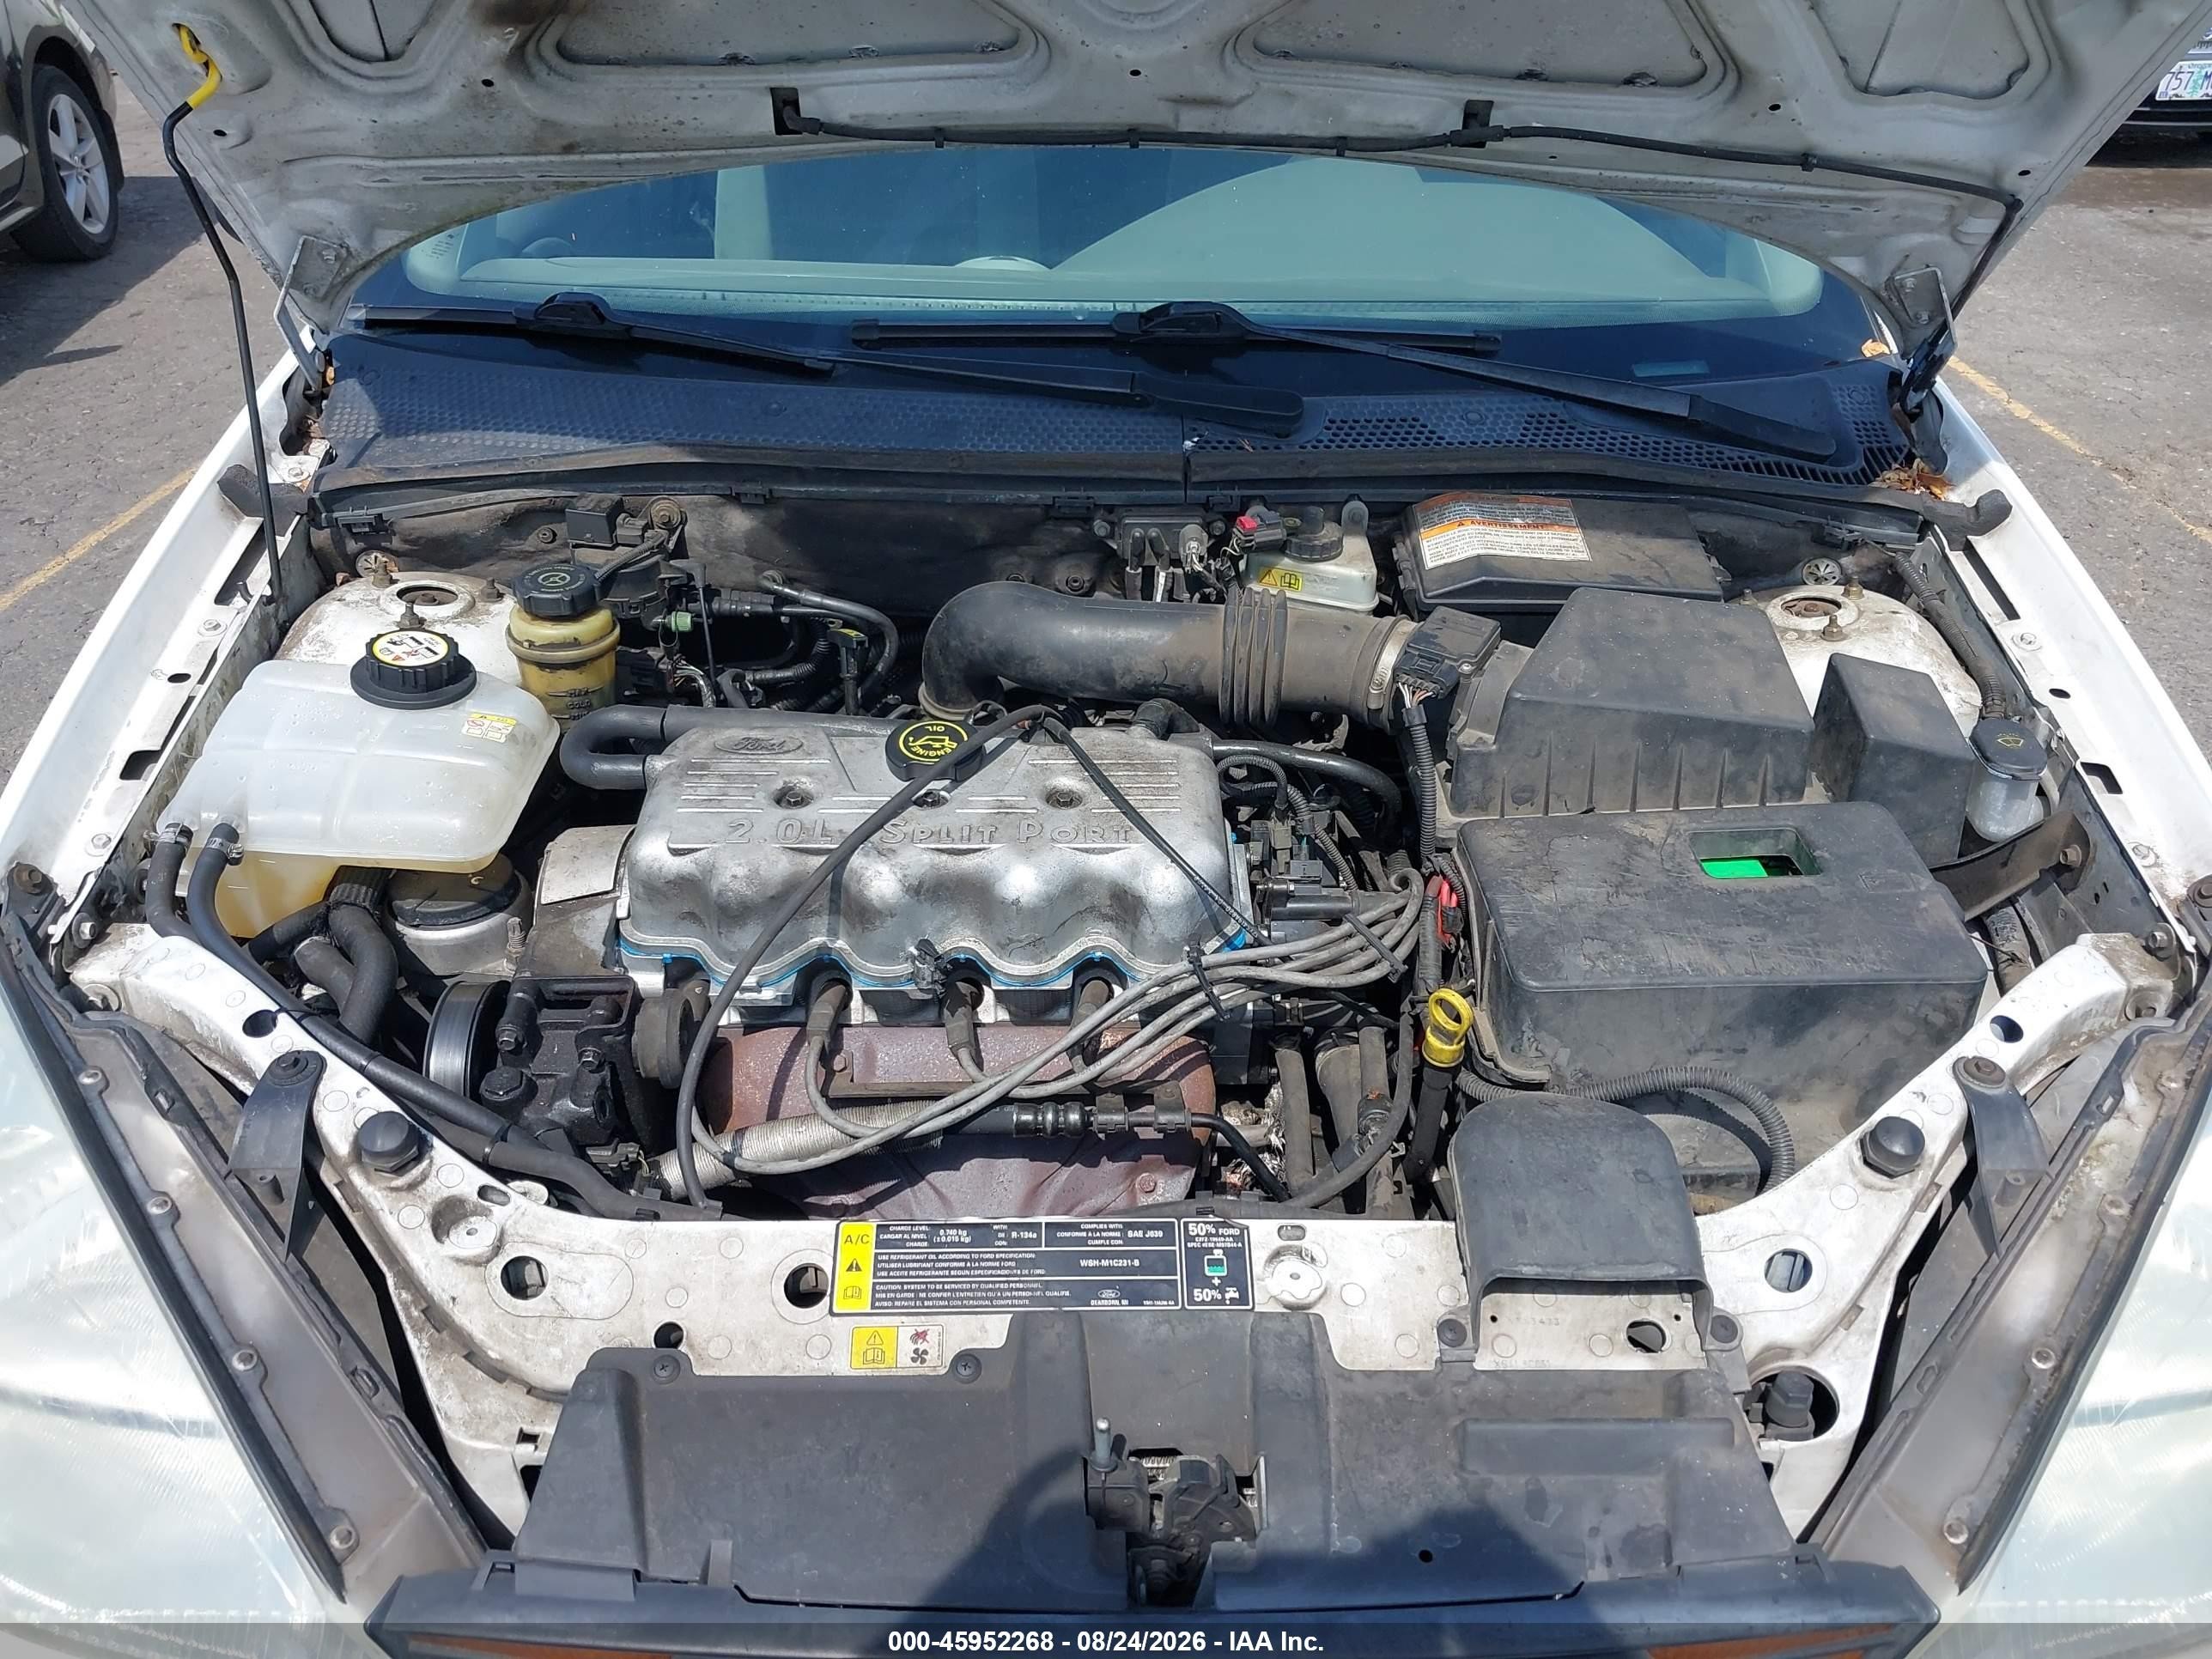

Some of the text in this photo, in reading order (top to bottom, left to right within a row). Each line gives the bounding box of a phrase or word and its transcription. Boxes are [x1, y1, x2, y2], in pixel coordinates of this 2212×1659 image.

[2165, 71, 2212, 91] 757 M
[1470, 520, 1546, 531] AVERTISSEMENT
[732, 736, 787, 751] Ford
[910, 745, 952, 757] ENGINE
[726, 818, 833, 844] 2.0L
[1188, 1222, 1216, 1236] 50%
[844, 1233, 870, 1244] A/C
[1079, 1259, 1140, 1267] WSH-M1C231-B
[1193, 1288, 1222, 1302] 50%
